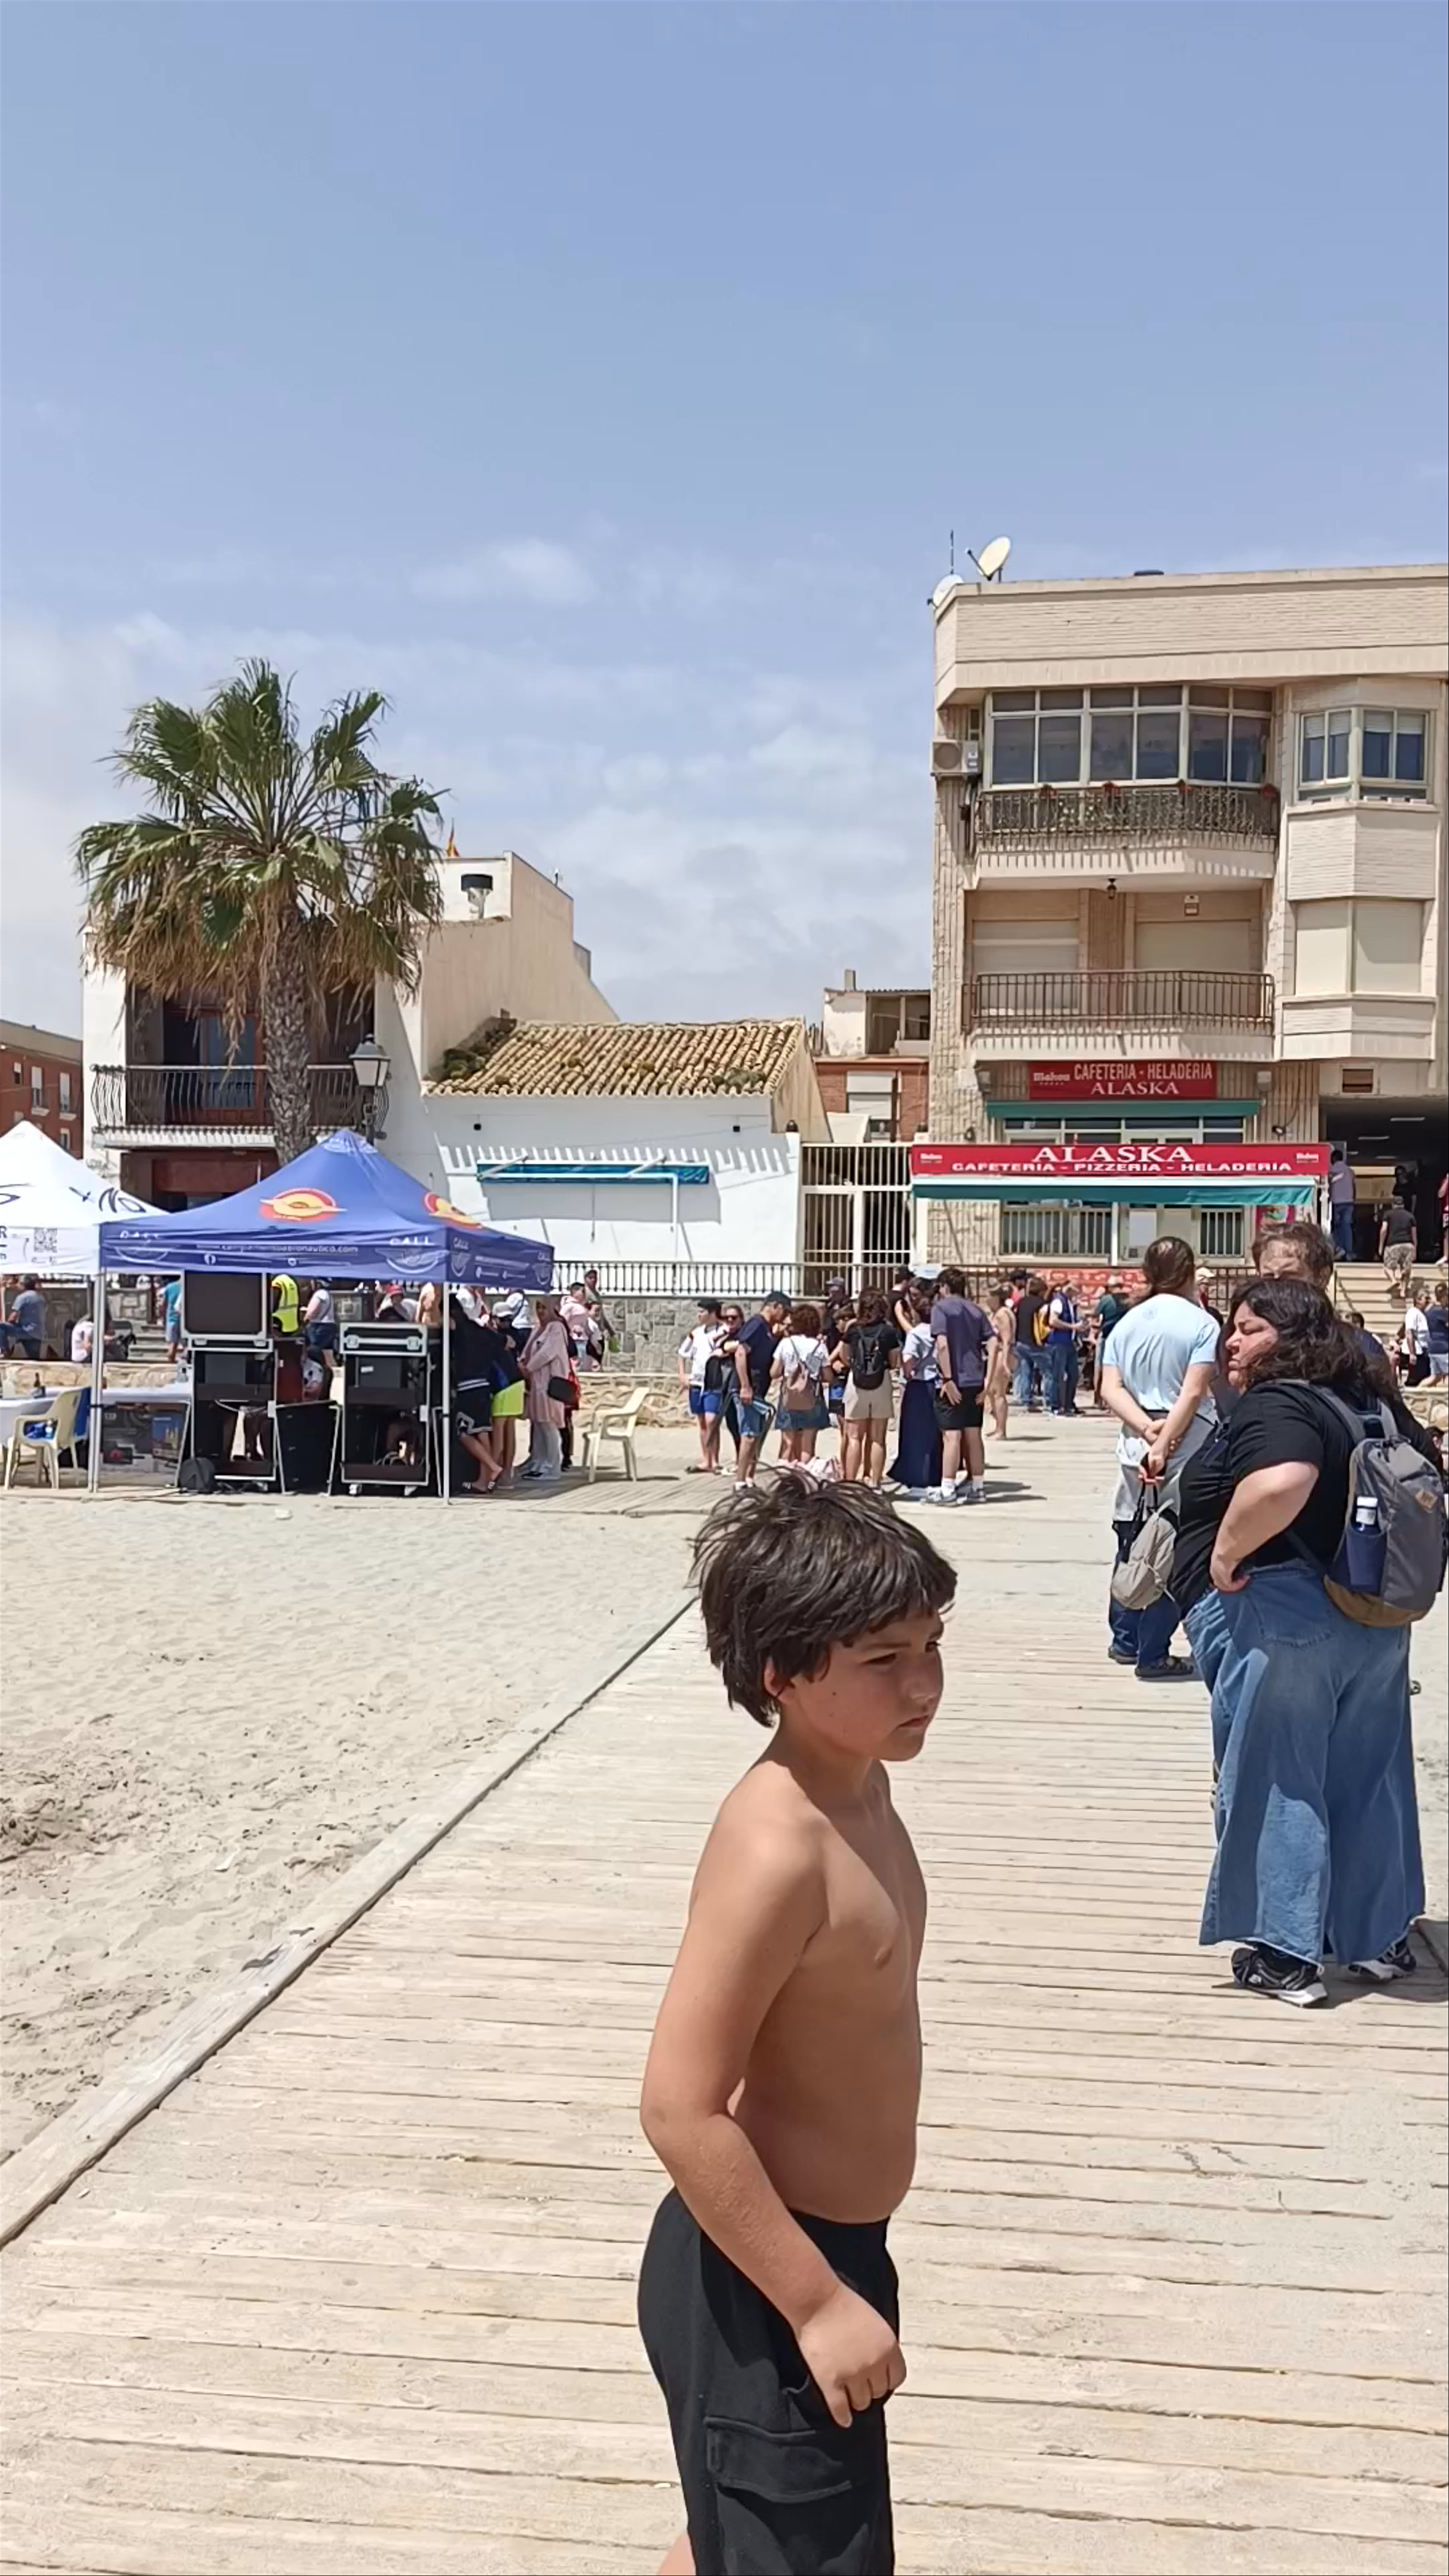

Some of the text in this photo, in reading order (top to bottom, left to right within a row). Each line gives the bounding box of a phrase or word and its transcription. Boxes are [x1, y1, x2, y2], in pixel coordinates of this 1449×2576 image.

[1074, 1063, 1136, 1080] CAFETERIA
[1148, 1063, 1212, 1080] HELADERIA
[1091, 1082, 1179, 1095] ALASKA
[1031, 1146, 1195, 1162] ALASKA
[952, 1163, 1055, 1171] CAFETERIA
[1181, 1163, 1292, 1171] HELADERIA
